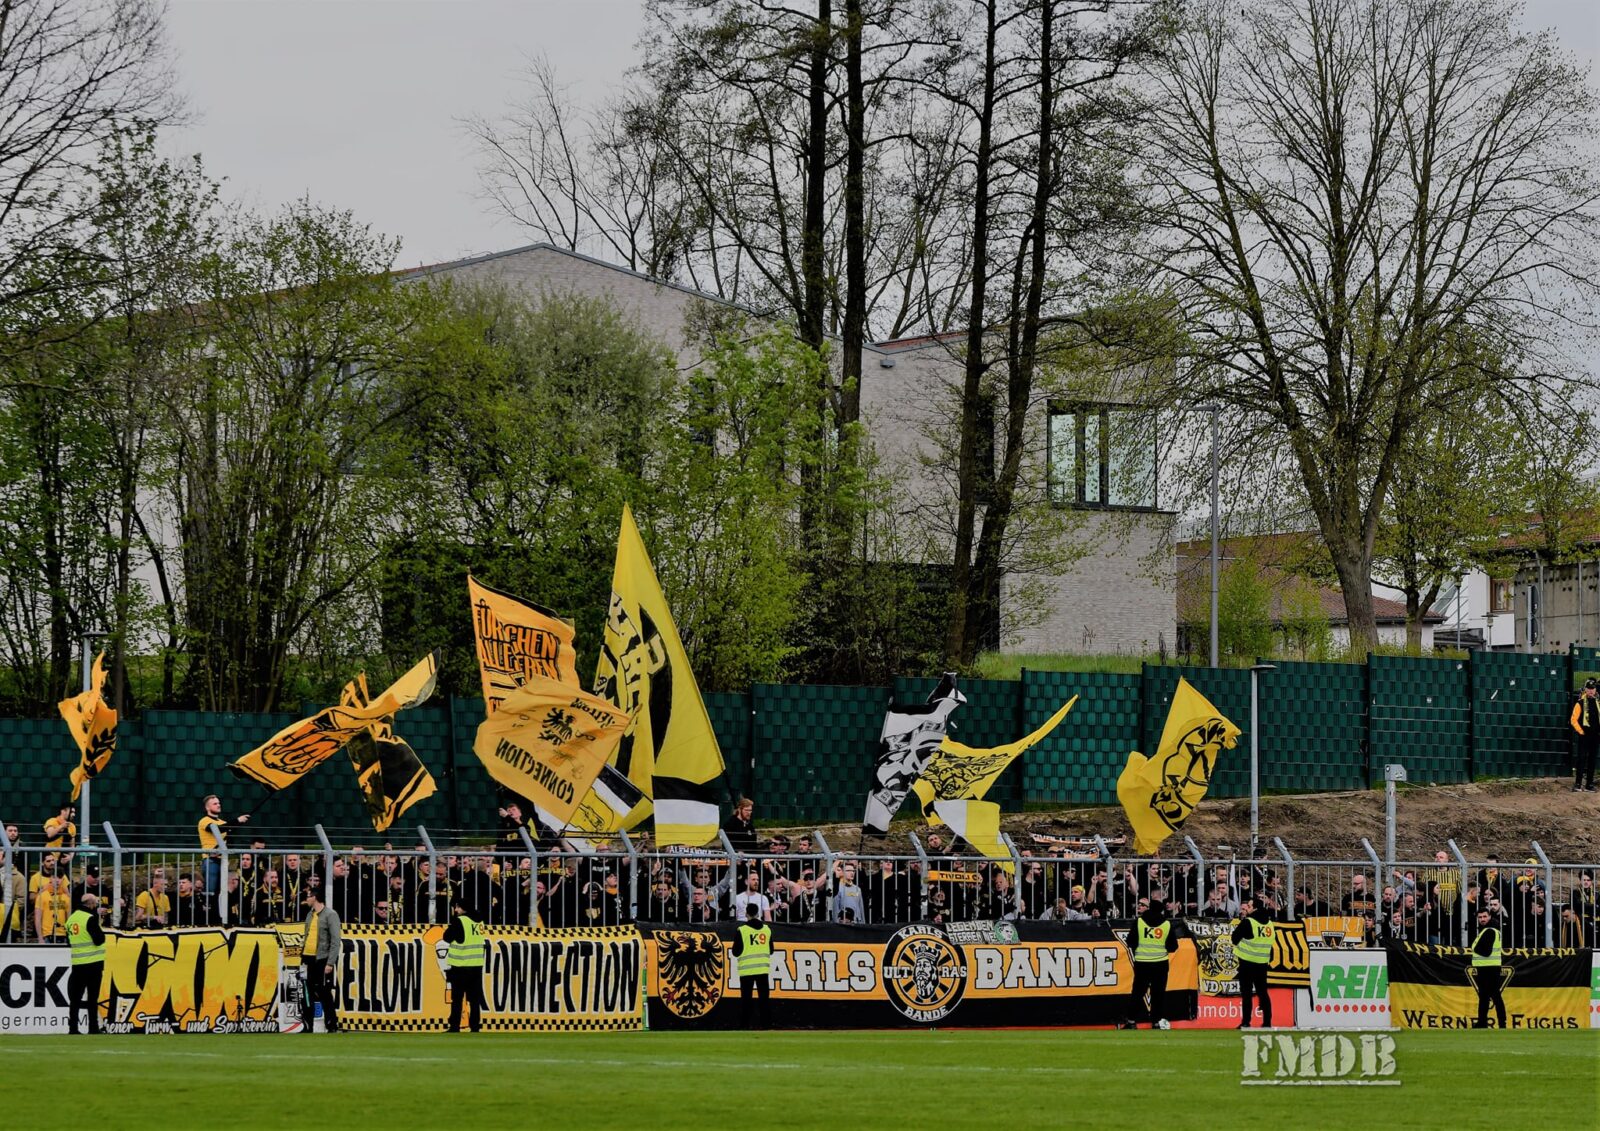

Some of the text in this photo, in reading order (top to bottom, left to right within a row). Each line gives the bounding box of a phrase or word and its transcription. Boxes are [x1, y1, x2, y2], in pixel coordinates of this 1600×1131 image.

[471, 924, 485, 936] K9
[898, 925, 943, 938] KARLS
[1144, 927, 1163, 939] K9
[1258, 926, 1272, 938] K9
[749, 933, 766, 945] K9
[1434, 944, 1577, 959] MEORIAM
[334, 938, 422, 1013] ELLOW
[974, 948, 1118, 989] BANDE
[904, 1006, 948, 1020] BANDE
[2, 1015, 70, 1029] german
[186, 1017, 209, 1032] und
